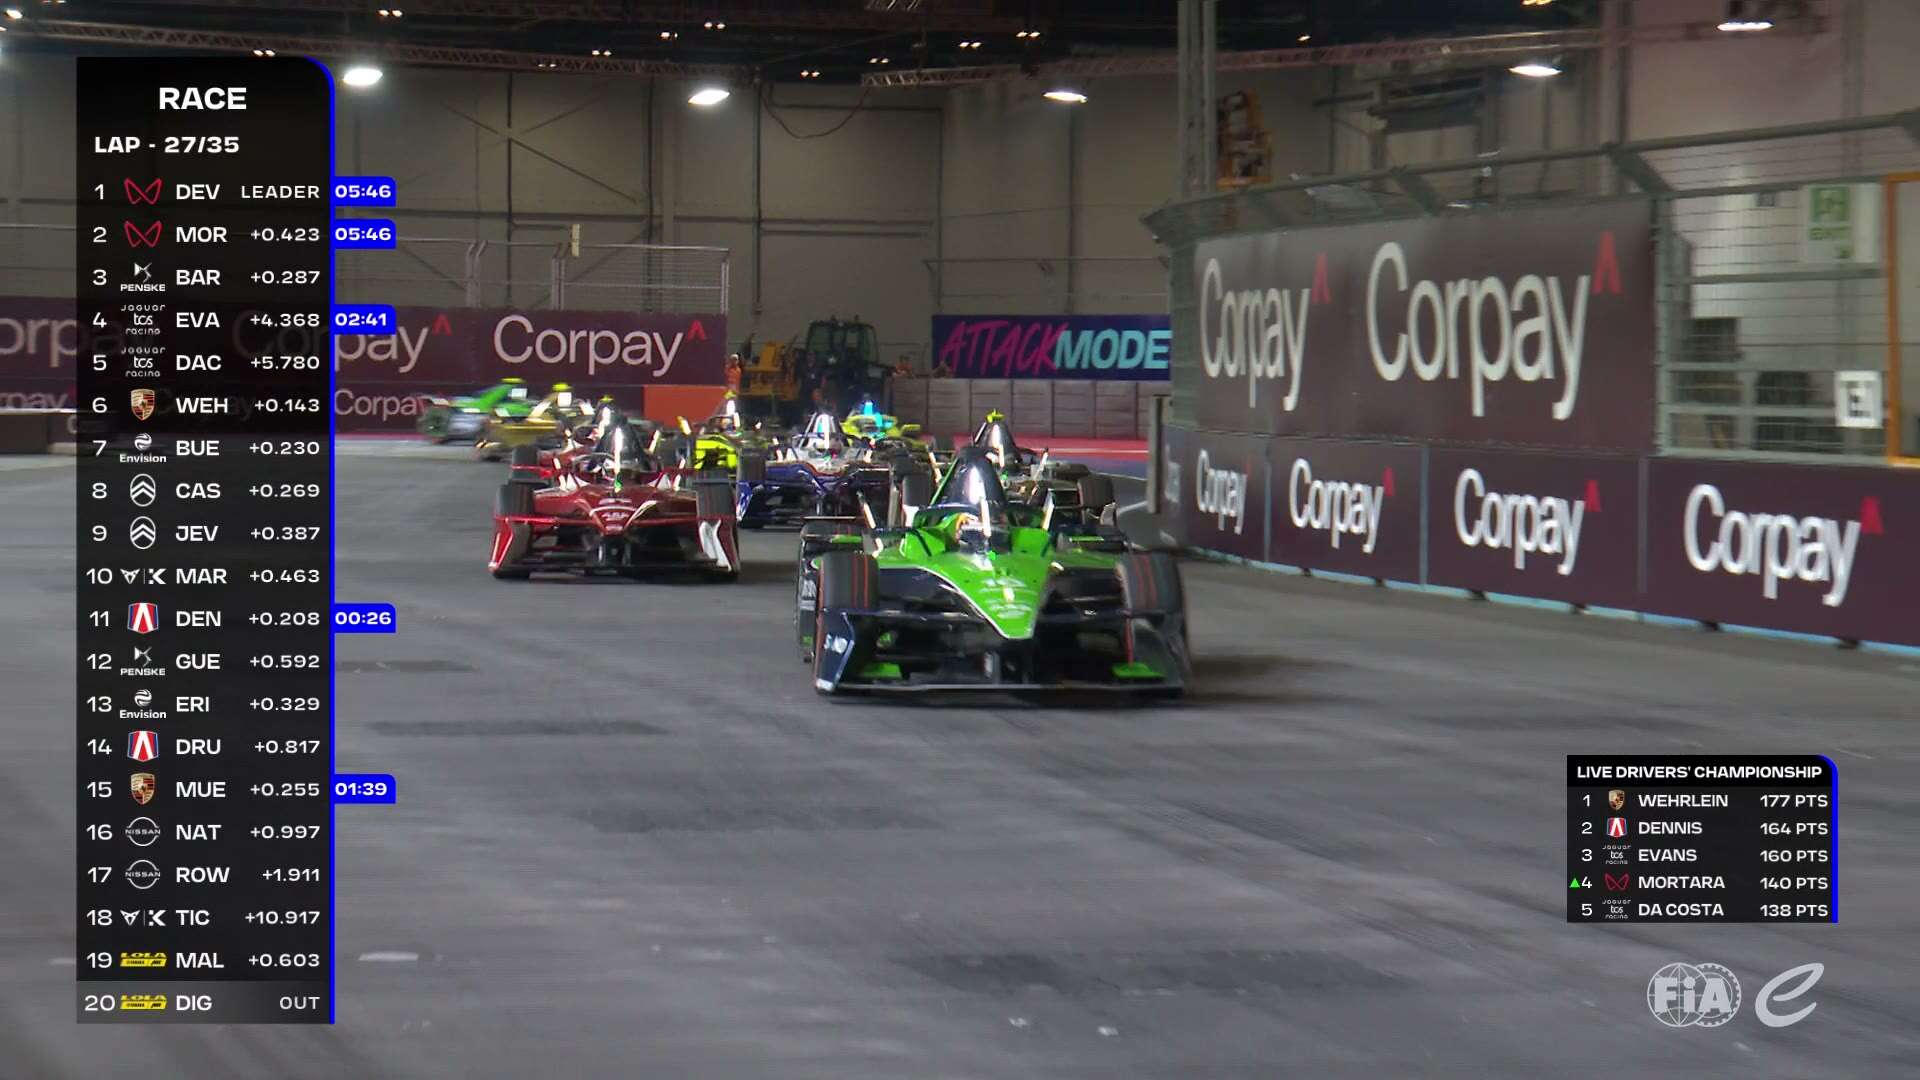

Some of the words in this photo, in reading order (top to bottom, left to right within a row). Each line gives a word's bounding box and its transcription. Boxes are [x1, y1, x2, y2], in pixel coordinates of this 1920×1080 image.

[493, 314, 684, 376] Corpay
[939, 320, 1069, 377] ATTACK
[1055, 329, 1171, 369] MODE
[1200, 258, 1310, 411] Corpay
[1366, 241, 1590, 421] Corpay
[1196, 448, 1247, 535] Corpay
[1289, 458, 1383, 553] Corpay
[1454, 468, 1585, 575] Corpay
[1684, 484, 1861, 607] Corpay
